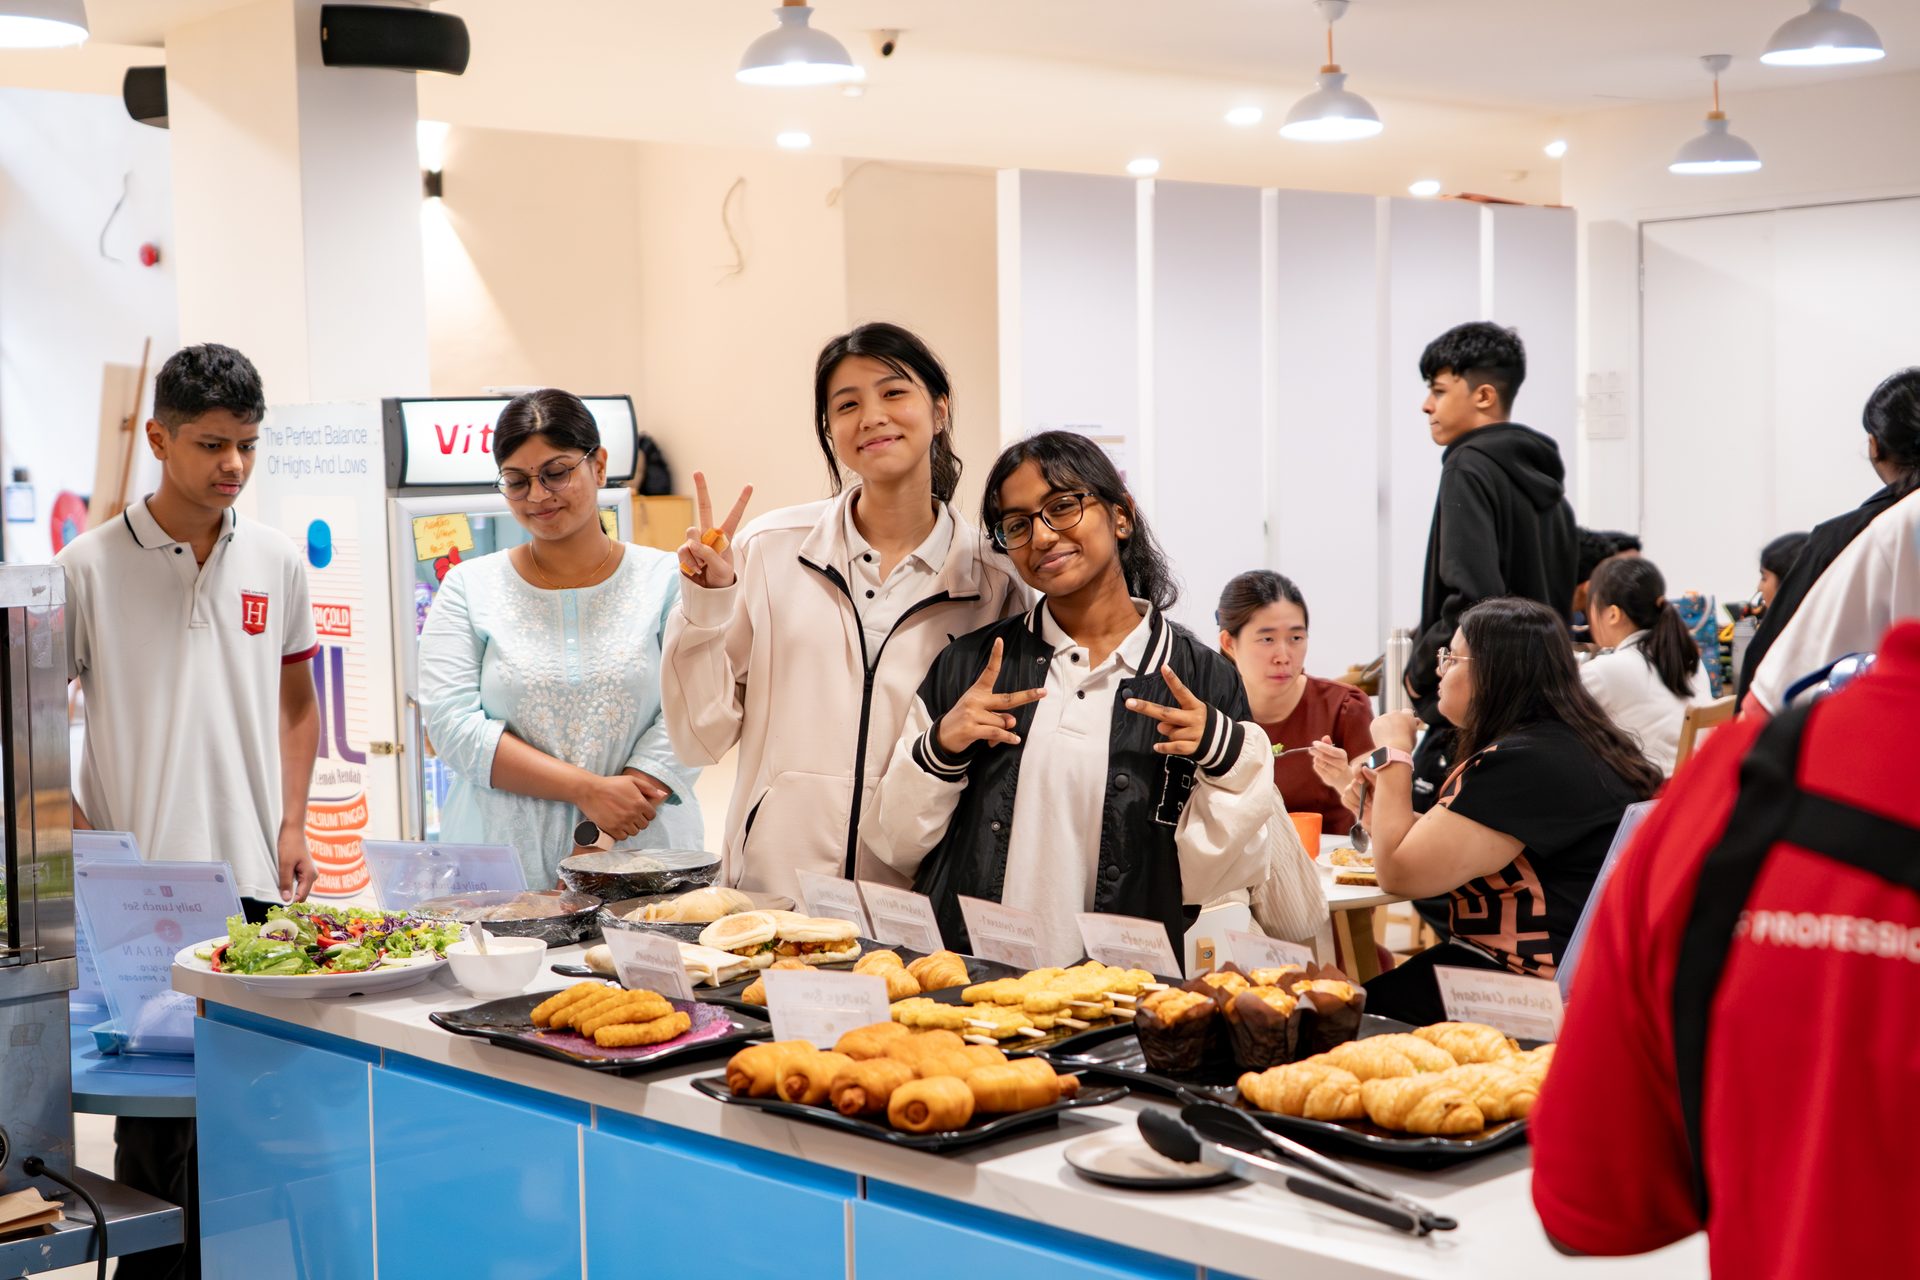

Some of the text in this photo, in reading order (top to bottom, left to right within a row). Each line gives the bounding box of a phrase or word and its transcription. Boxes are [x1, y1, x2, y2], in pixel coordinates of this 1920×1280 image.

[264, 425, 368, 446] The Perfect Balance
[267, 455, 368, 479] Of Highs And Lows
[244, 600, 266, 626] H
[315, 768, 361, 785] Lemak Rendah
